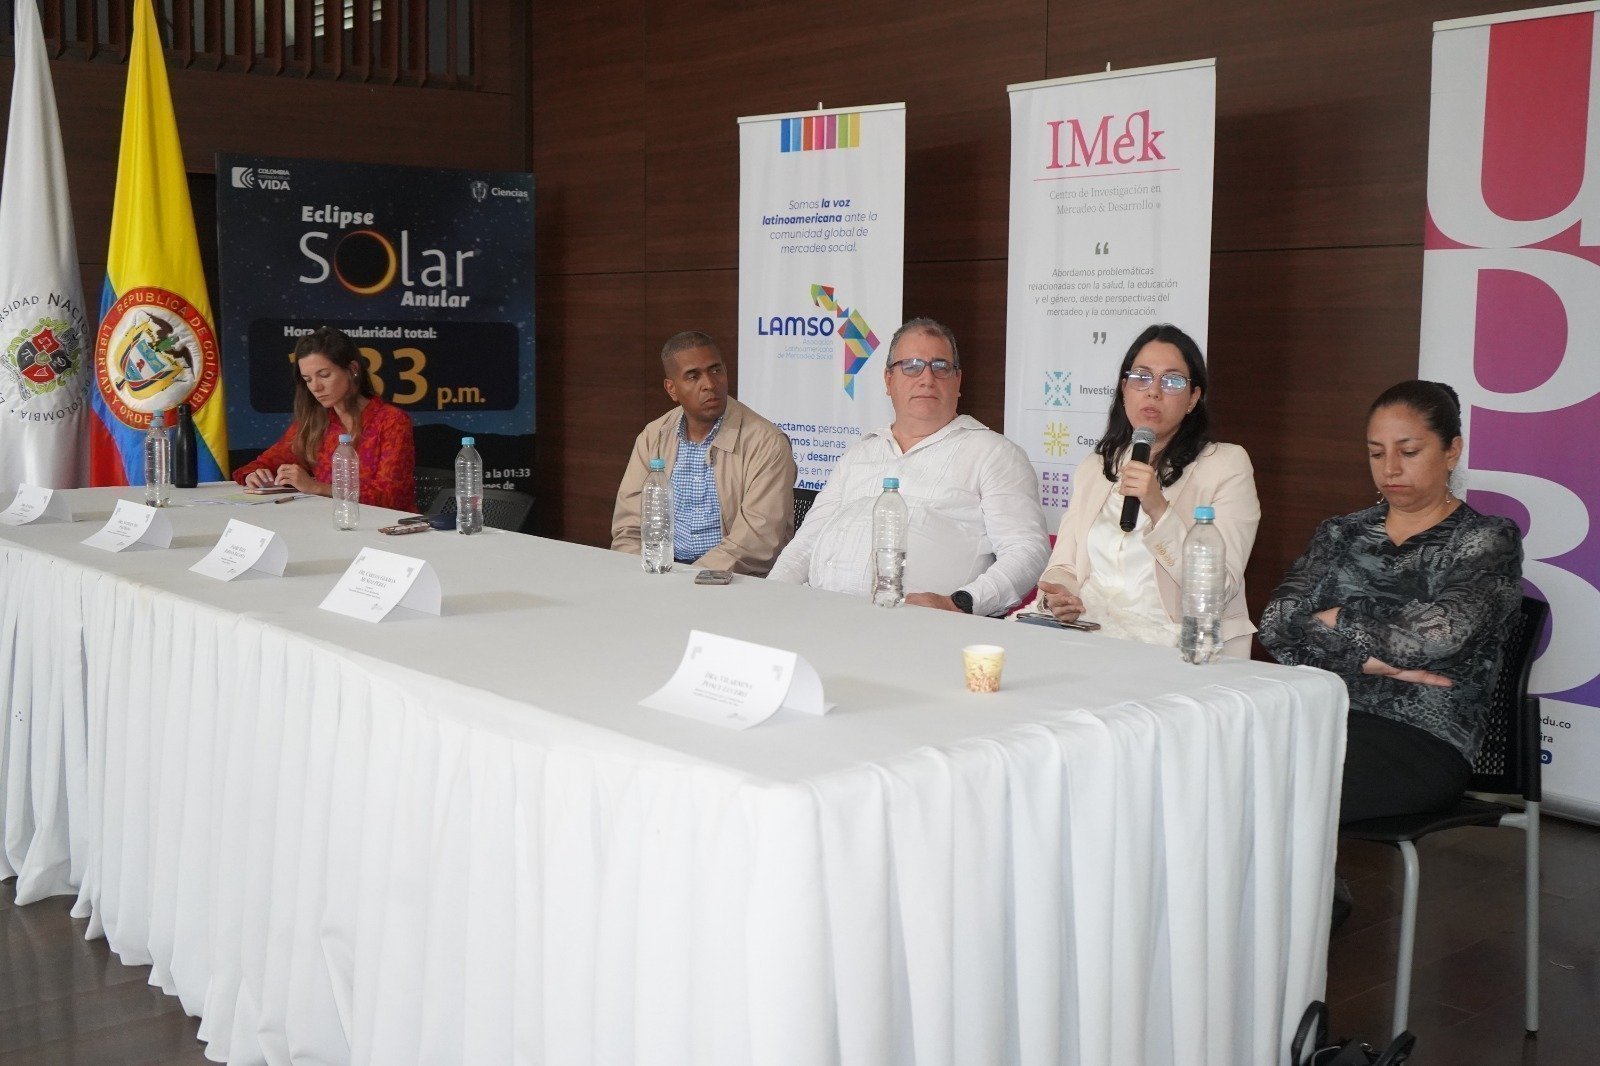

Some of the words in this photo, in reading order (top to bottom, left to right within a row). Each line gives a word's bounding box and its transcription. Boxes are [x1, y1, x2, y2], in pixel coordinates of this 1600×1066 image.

[258, 179, 290, 190] VIDA
[491, 187, 528, 198] Ciencias
[1049, 190, 1076, 200] Centro
[1079, 188, 1088, 198] de
[1091, 184, 1148, 197] Investigación
[1151, 185, 1161, 193] en
[789, 200, 819, 210] Somos
[821, 199, 830, 208] la
[833, 199, 850, 208] voz
[1056, 203, 1096, 215] Mercadeo
[1108, 200, 1153, 212] Desarrollo
[301, 204, 374, 229] Eclipse
[762, 213, 842, 226] latinoamericana
[845, 213, 866, 223] ante
[868, 211, 878, 221] la
[770, 228, 822, 239] comunidad
[824, 227, 854, 240] global
[856, 227, 869, 237] de
[781, 243, 826, 254] mercadeo
[828, 242, 857, 252] social.
[1052, 268, 1095, 277] Abordamos
[1098, 266, 1154, 278] problemáticas
[1028, 281, 1075, 291] relacionadas
[1077, 282, 1091, 290] con
[1093, 281, 1100, 290] la
[1102, 280, 1125, 290] salud,
[1127, 280, 1134, 289] la
[1137, 278, 1178, 289] educación
[117, 292, 187, 318] REPUBLICA
[401, 290, 470, 308] Anular
[1034, 296, 1040, 304] y
[1041, 295, 1049, 303] el
[1051, 293, 1078, 305] género,
[1080, 294, 1103, 303] desde
[1105, 294, 1156, 305] perspectivas
[1158, 293, 1170, 302] del
[1047, 307, 1083, 316] mercadeo
[1085, 309, 1090, 317] y
[1091, 307, 1098, 316] la
[190, 316, 209, 337] DE
[284, 326, 314, 337] Hora
[341, 326, 401, 338] nularidad
[404, 327, 437, 339] total:
[758, 316, 834, 336] LAMSO
[189, 340, 216, 408] COLOMBI
[437, 385, 486, 410] p.m.
[1080, 384, 1116, 398] Investig
[21, 396, 83, 422] COLOMBIA
[119, 406, 152, 424] ORDE
[773, 422, 816, 433] ectamos
[818, 425, 862, 436] personas,
[812, 437, 846, 449] buenas
[1077, 435, 1100, 447] Capa
[800, 453, 805, 462] y
[493, 469, 501, 478] la
[503, 468, 531, 478] 01:33
[811, 467, 822, 476] en
[503, 481, 515, 490] de
